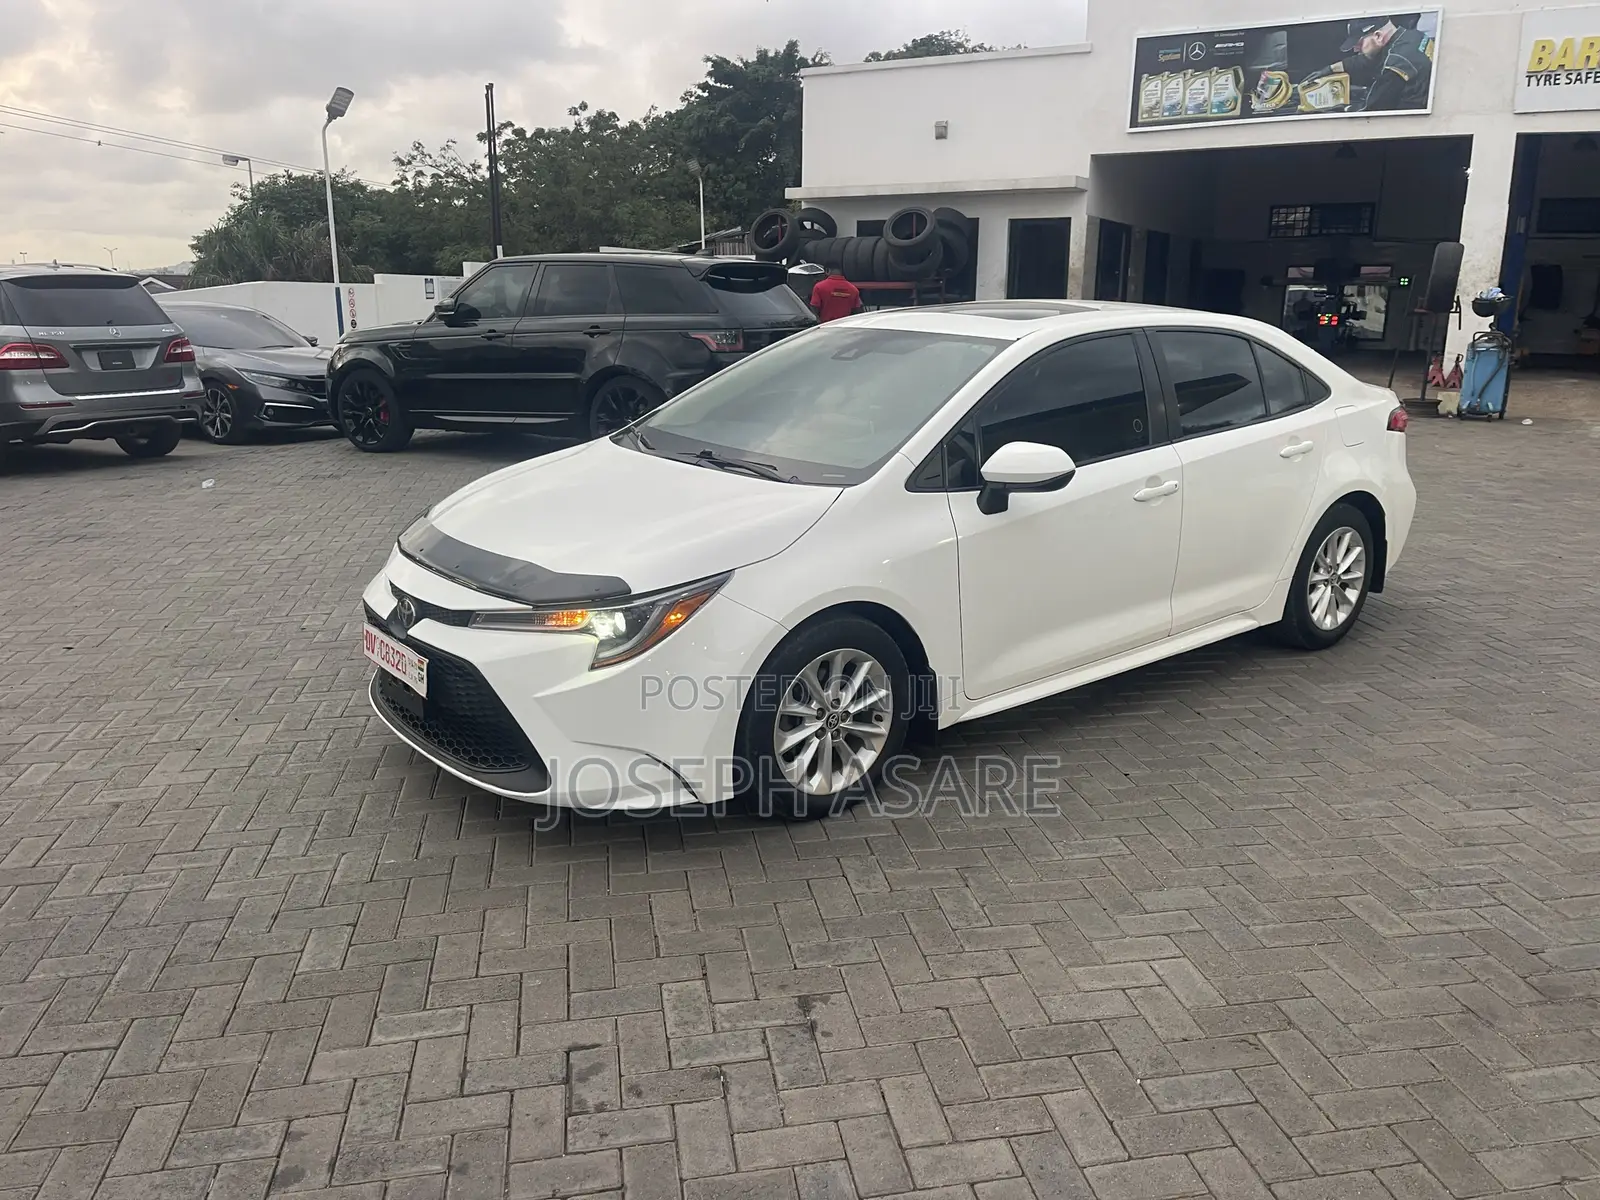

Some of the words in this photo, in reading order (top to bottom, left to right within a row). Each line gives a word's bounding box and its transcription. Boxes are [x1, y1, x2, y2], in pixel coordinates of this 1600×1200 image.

[1527, 36, 1600, 73] BAR
[1526, 73, 1561, 87] TYRE
[365, 629, 376, 655] DV
